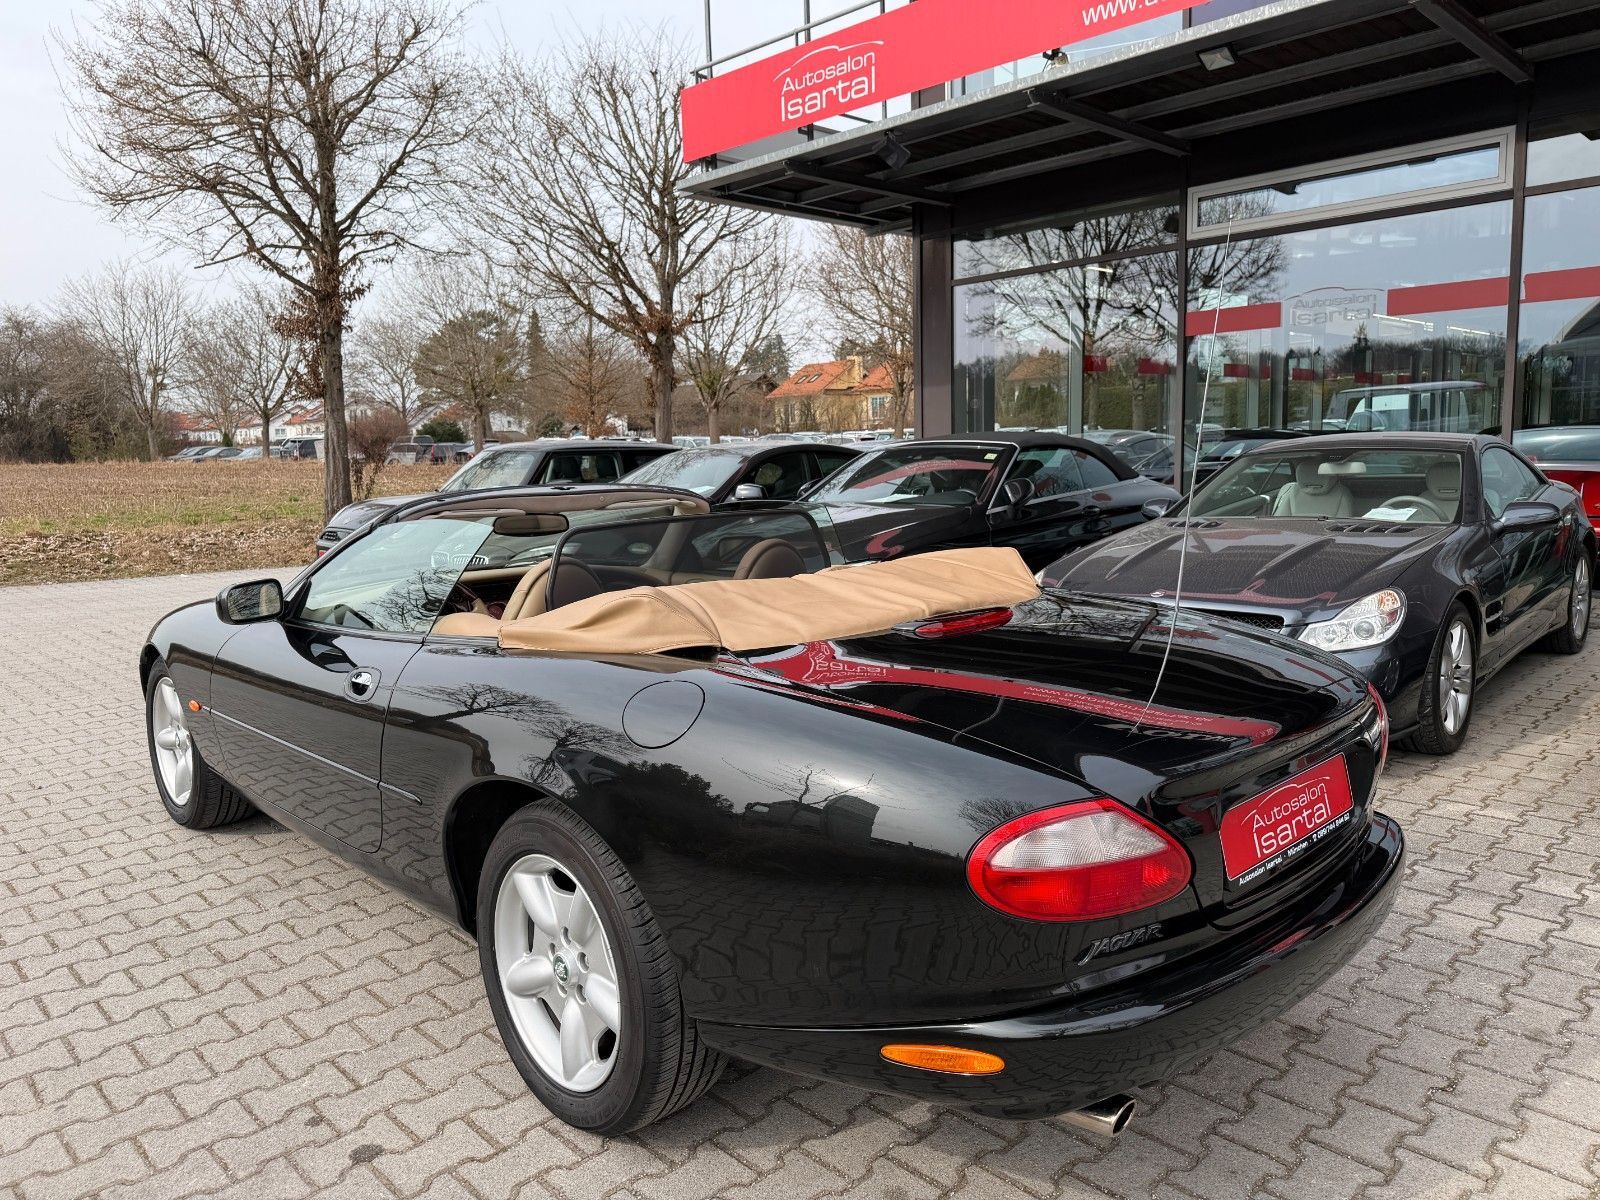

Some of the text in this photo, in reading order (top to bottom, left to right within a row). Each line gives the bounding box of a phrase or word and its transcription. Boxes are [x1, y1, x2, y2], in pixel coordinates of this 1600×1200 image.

[781, 51, 875, 95] Autosalon
[781, 65, 876, 122] Isartal
[1289, 303, 1377, 327] Isartal
[1293, 293, 1377, 309] Autosalon
[1253, 783, 1327, 832] Autosalon
[1253, 793, 1332, 858] Isartal
[1239, 866, 1266, 886] Autosalon
[1265, 854, 1283, 870] Isartal
[1078, 922, 1164, 966] JAGUAR
